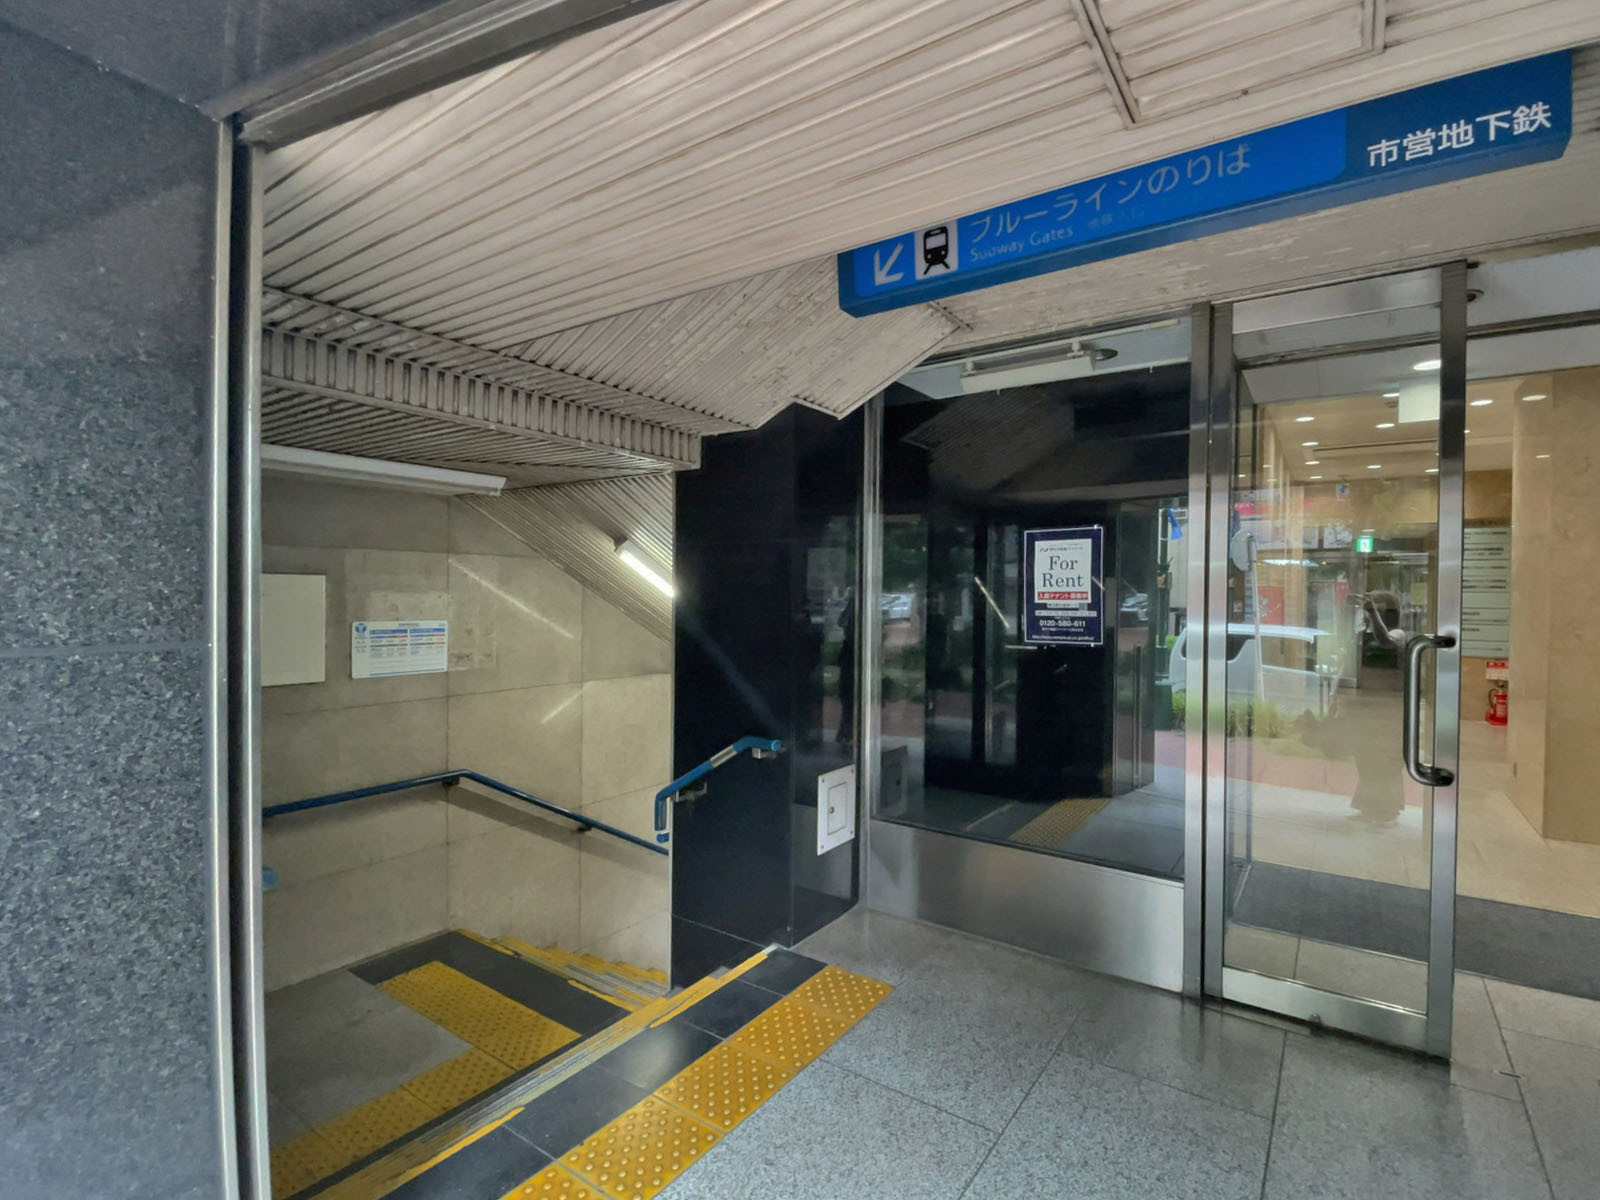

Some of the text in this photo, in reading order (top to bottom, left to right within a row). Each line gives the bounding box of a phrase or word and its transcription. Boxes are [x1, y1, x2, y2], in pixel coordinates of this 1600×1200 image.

[1367, 101, 1552, 167] 市営地下鉄
[969, 226, 1074, 263] Subway Gates
[1048, 555, 1079, 571] For
[1041, 572, 1085, 588] Rent
